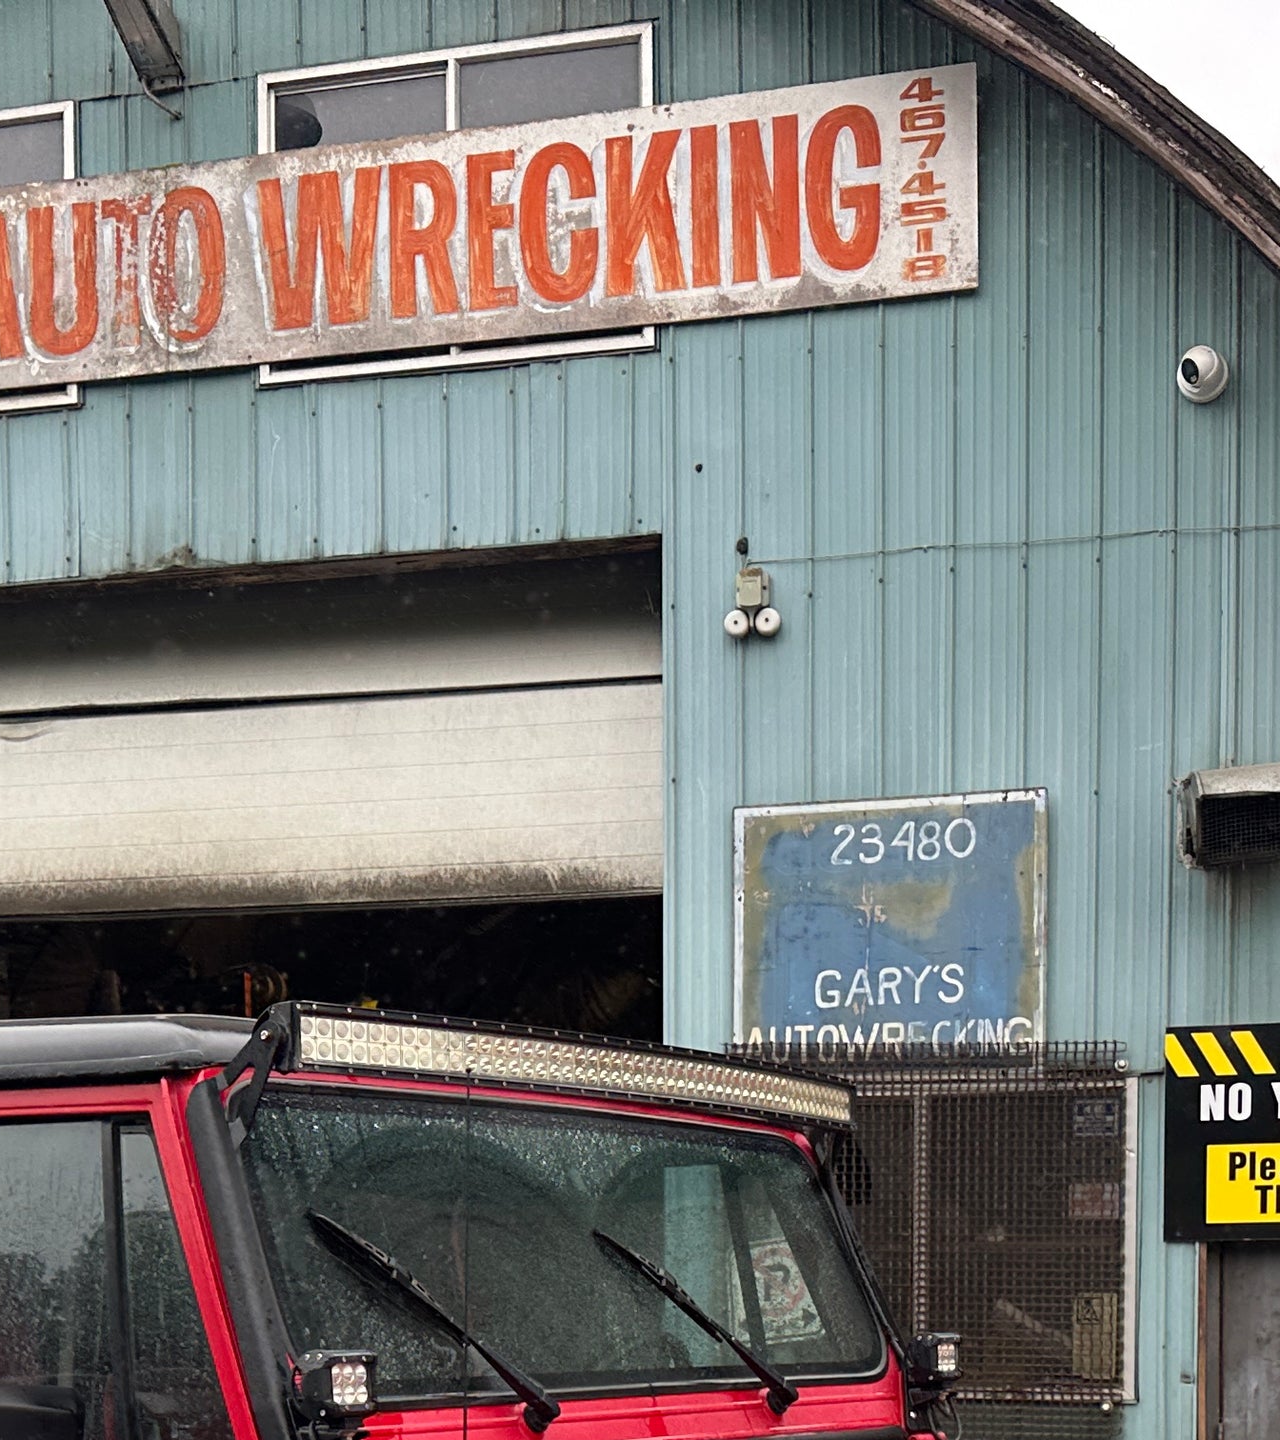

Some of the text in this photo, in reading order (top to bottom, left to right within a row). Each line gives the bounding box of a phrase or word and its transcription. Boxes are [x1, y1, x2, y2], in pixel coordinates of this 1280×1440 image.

[256, 103, 883, 332] WRECKING
[830, 817, 977, 866] 23480
[814, 962, 966, 1009] GARY'S
[1199, 1081, 1252, 1122] NO
